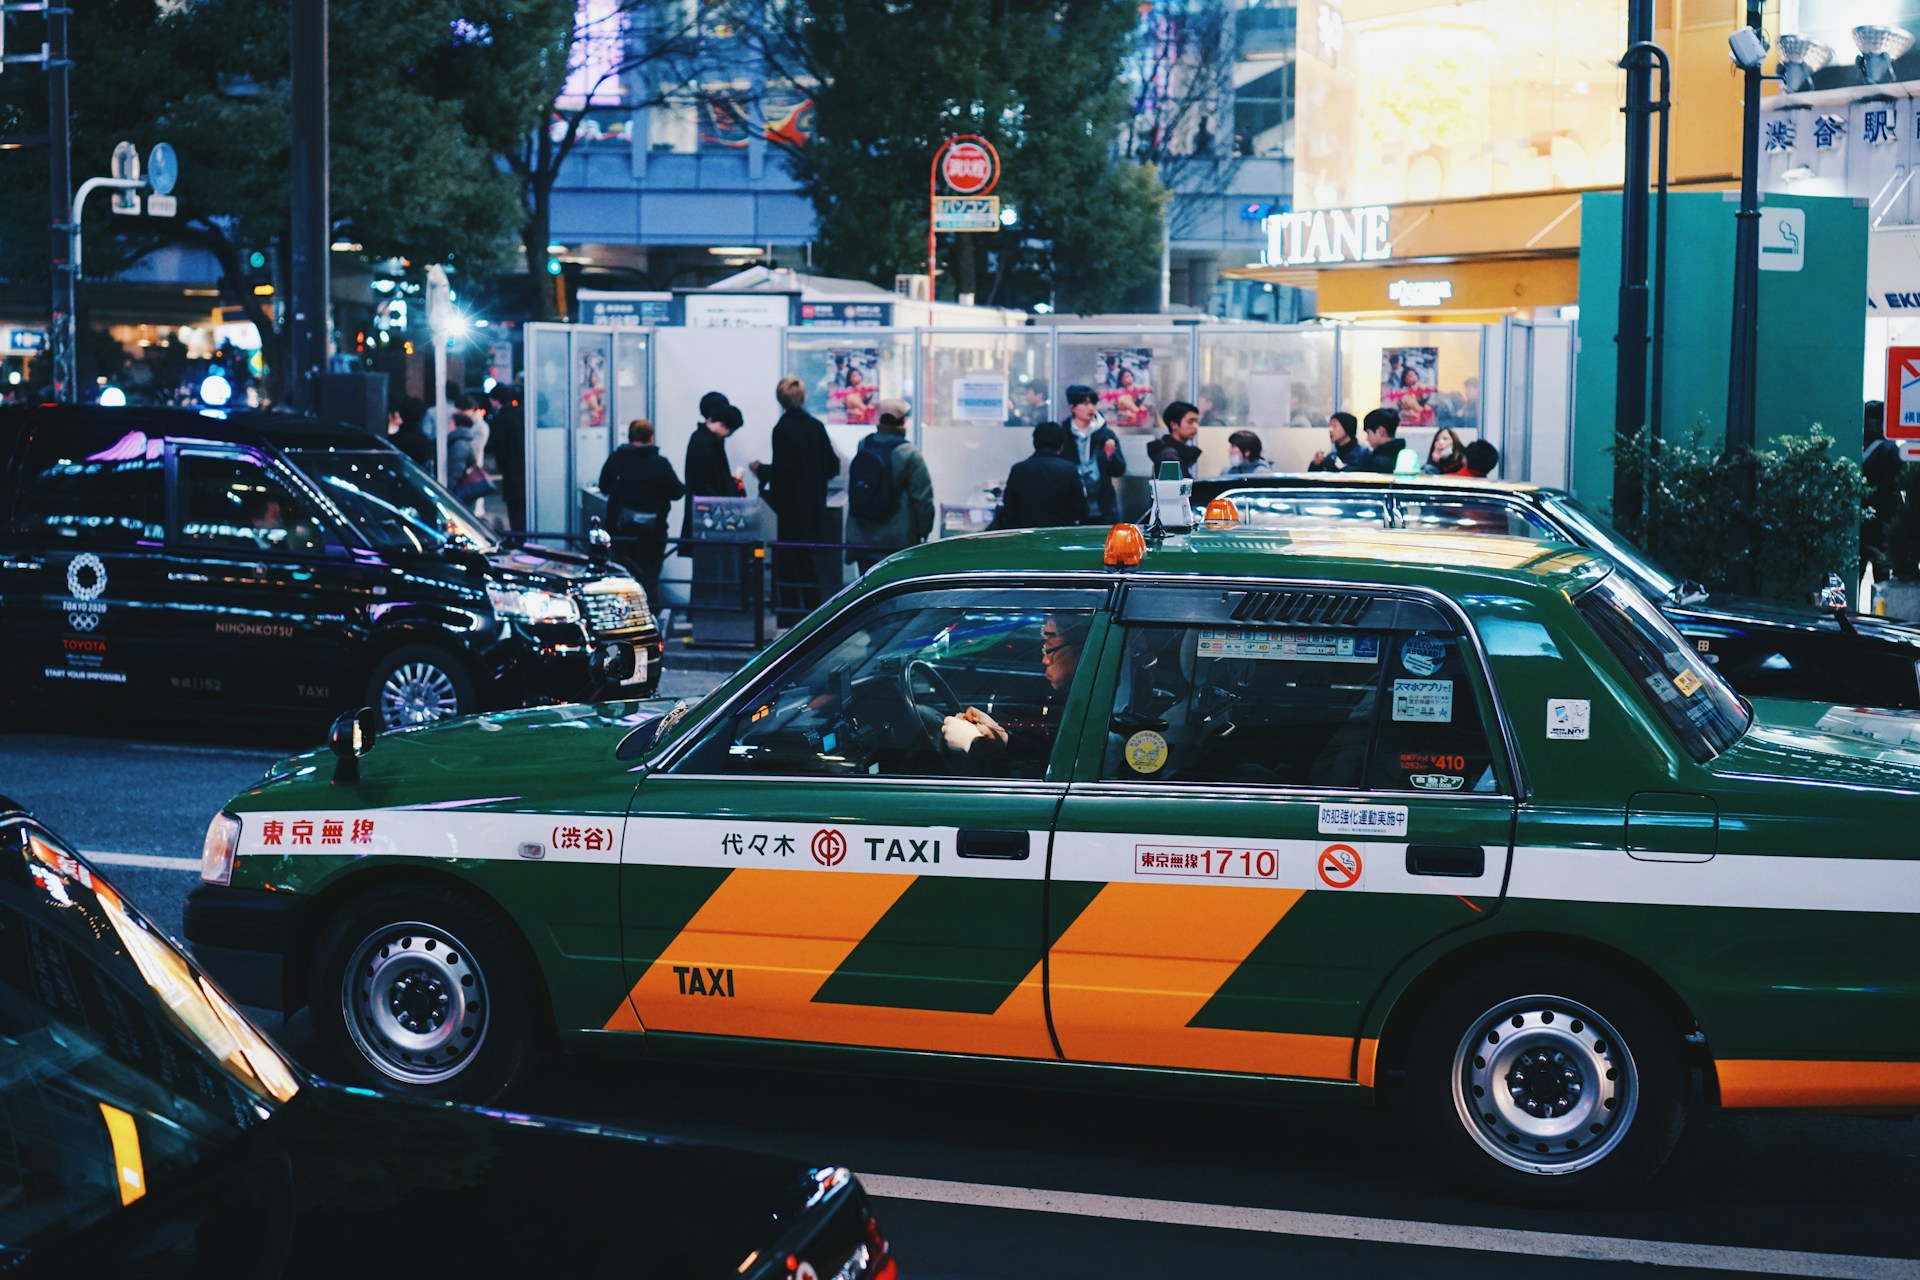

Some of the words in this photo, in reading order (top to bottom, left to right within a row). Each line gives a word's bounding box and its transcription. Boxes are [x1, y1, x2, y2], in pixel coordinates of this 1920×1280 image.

[1765, 109, 1920, 151] 渋谷駅
[1884, 293, 1920, 309] EKI
[62, 601, 87, 612] TOKYO
[88, 603, 107, 613] 2020
[215, 622, 293, 637] NIHONKOTSU
[63, 640, 106, 651] TOYOTA
[297, 685, 329, 698] TAXI
[1430, 755, 1465, 771] ¥410
[1321, 808, 1405, 828] 防犯強化運動実施中
[263, 819, 375, 845] 東京無線
[552, 826, 614, 851] (渋谷)
[721, 833, 795, 857] 代々木
[864, 837, 940, 863] TAXI
[673, 966, 735, 998] TAXI
